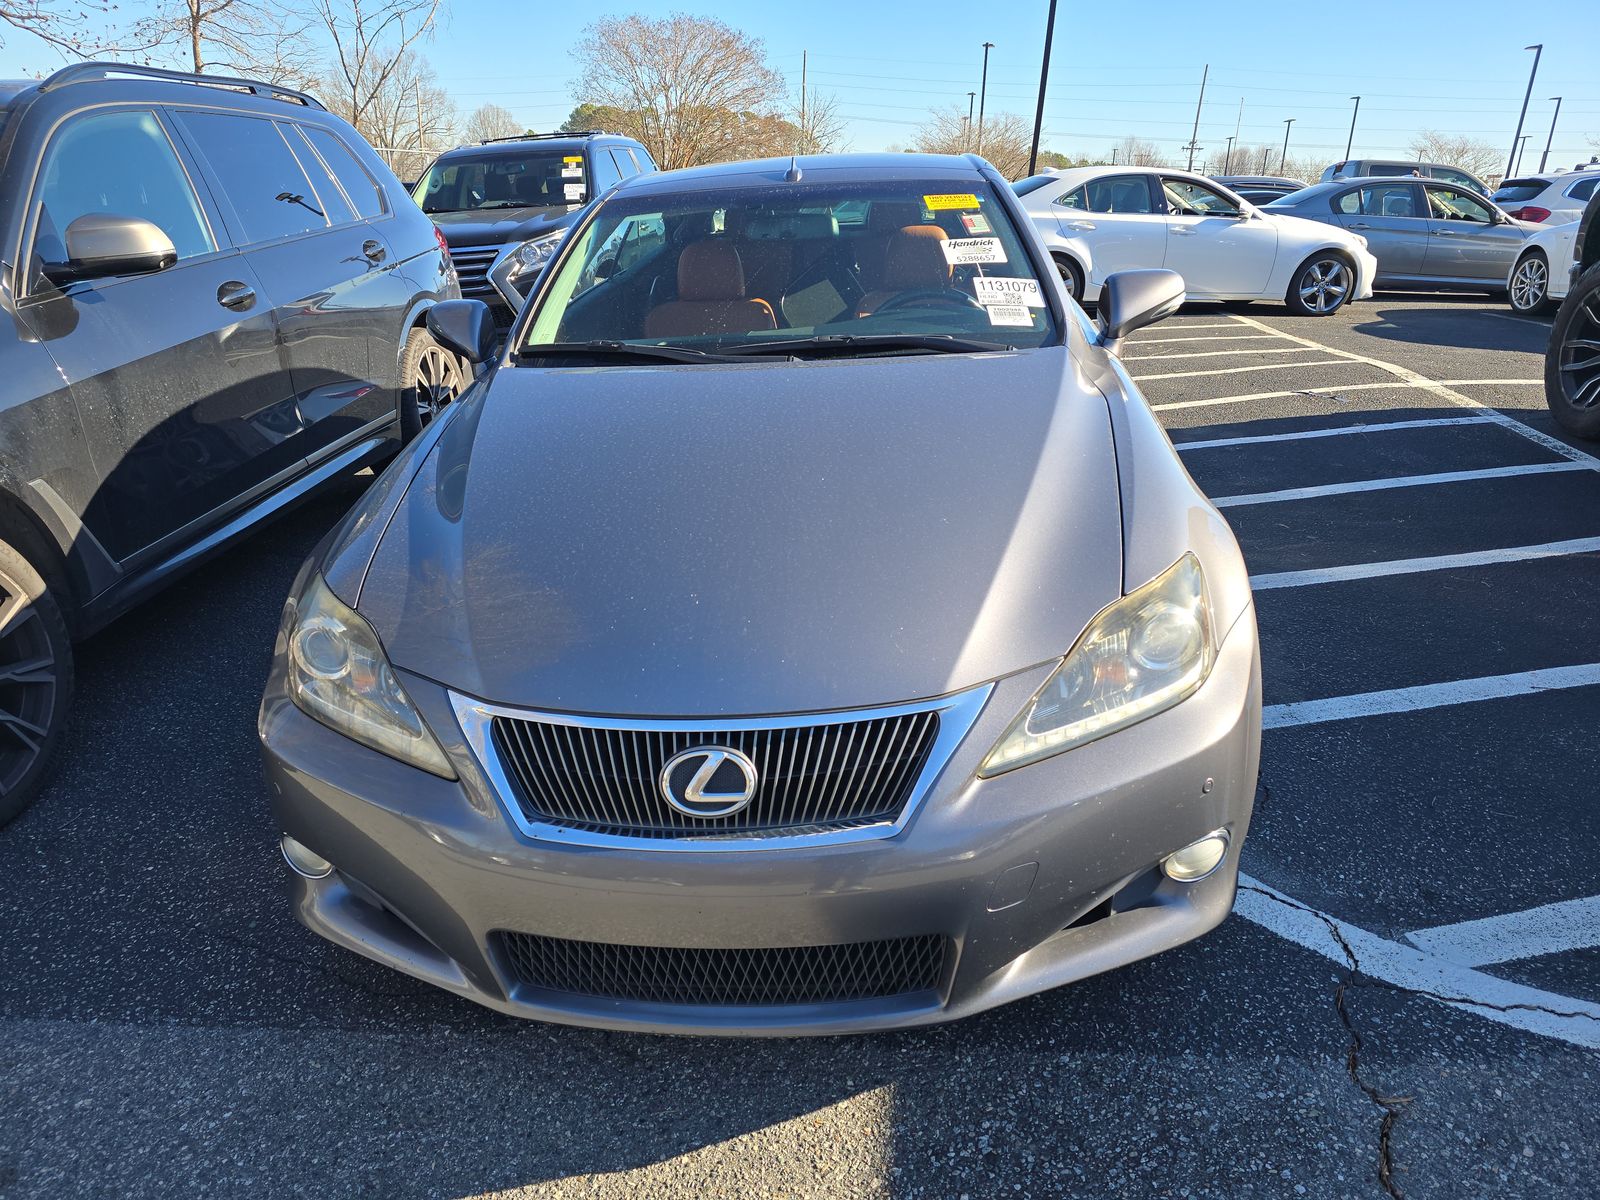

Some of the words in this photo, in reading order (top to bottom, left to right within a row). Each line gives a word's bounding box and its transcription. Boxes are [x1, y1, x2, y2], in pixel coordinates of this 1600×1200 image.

[948, 239, 994, 249] Hendrick
[956, 254, 996, 263] 5288657
[979, 280, 1037, 294] 1131079
